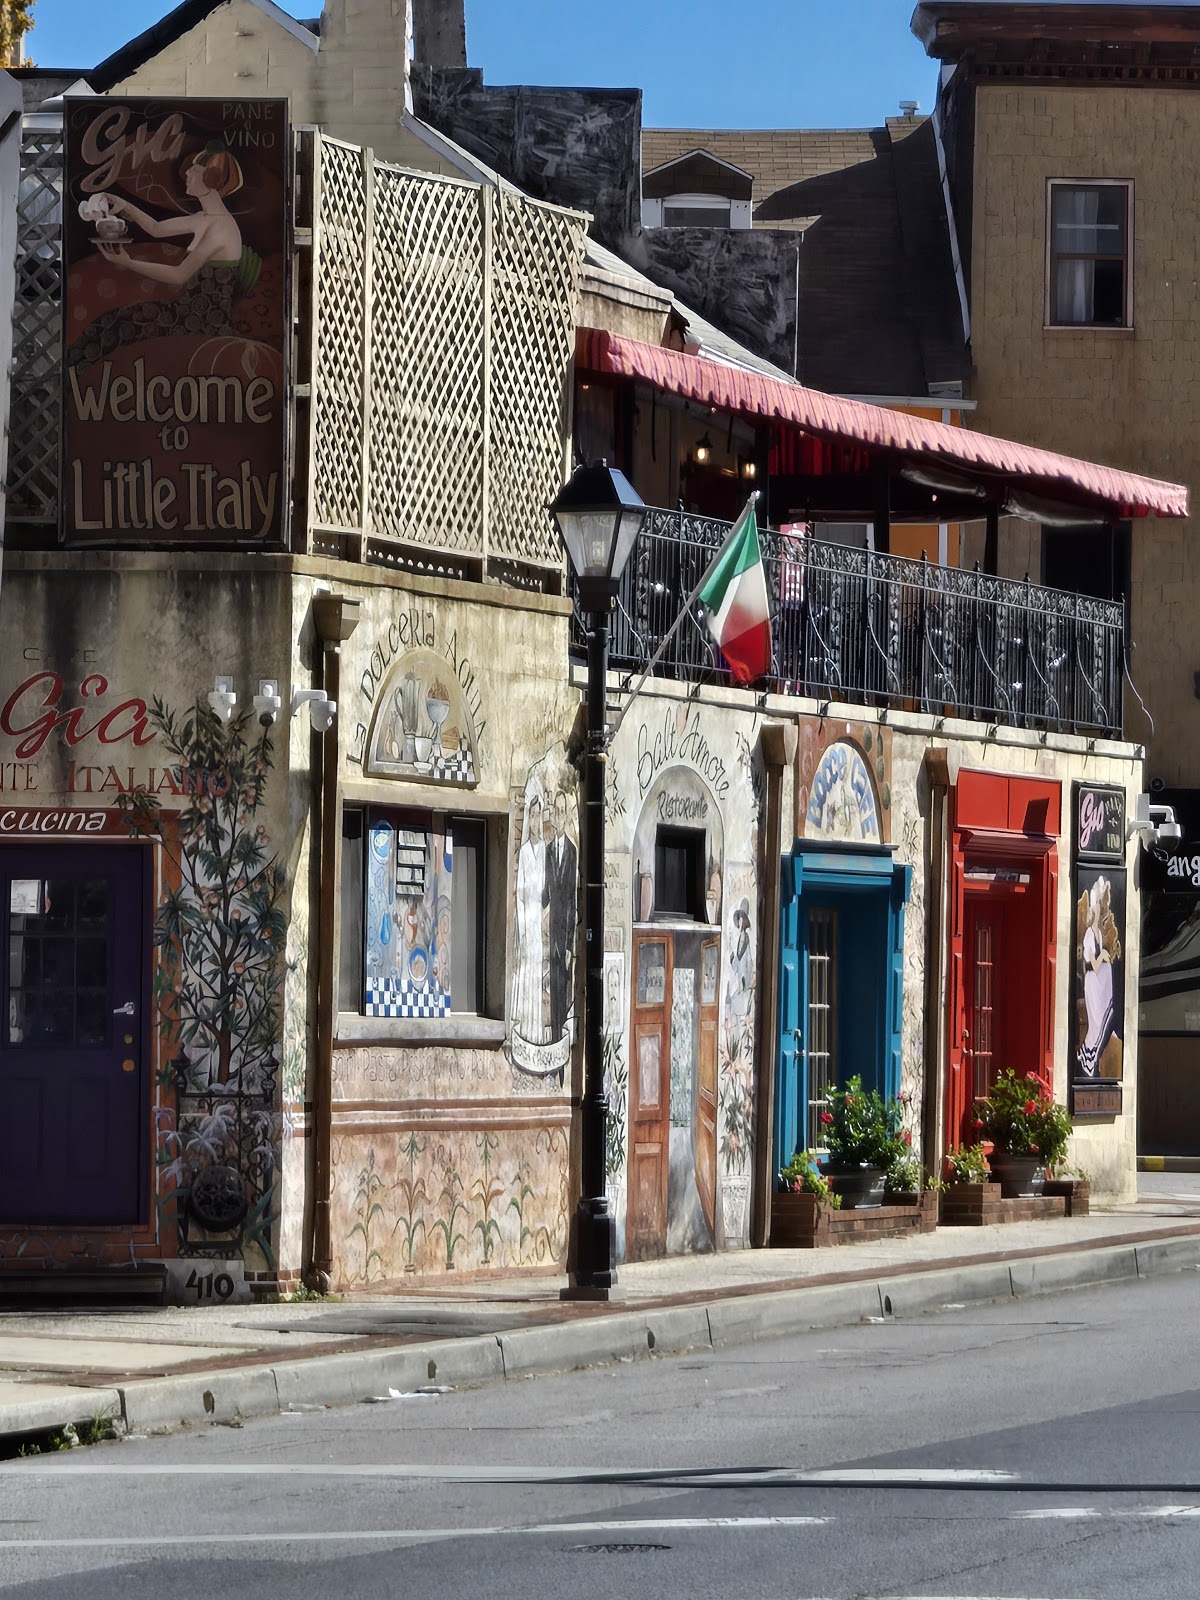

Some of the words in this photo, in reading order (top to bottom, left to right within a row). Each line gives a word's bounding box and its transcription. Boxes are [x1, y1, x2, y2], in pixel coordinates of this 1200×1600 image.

[222, 103, 273, 121] PANE
[80, 106, 186, 193] Gia
[223, 129, 275, 149] VINO
[68, 357, 275, 424] Welcome
[158, 425, 189, 450] to
[72, 458, 178, 530] Little
[181, 460, 278, 538] Italy
[1, 671, 157, 759] Gia
[679, 712, 730, 801] Amore
[66, 761, 233, 796] ITALIANO
[0, 810, 107, 832] cucina
[185, 1268, 235, 1299] 410
